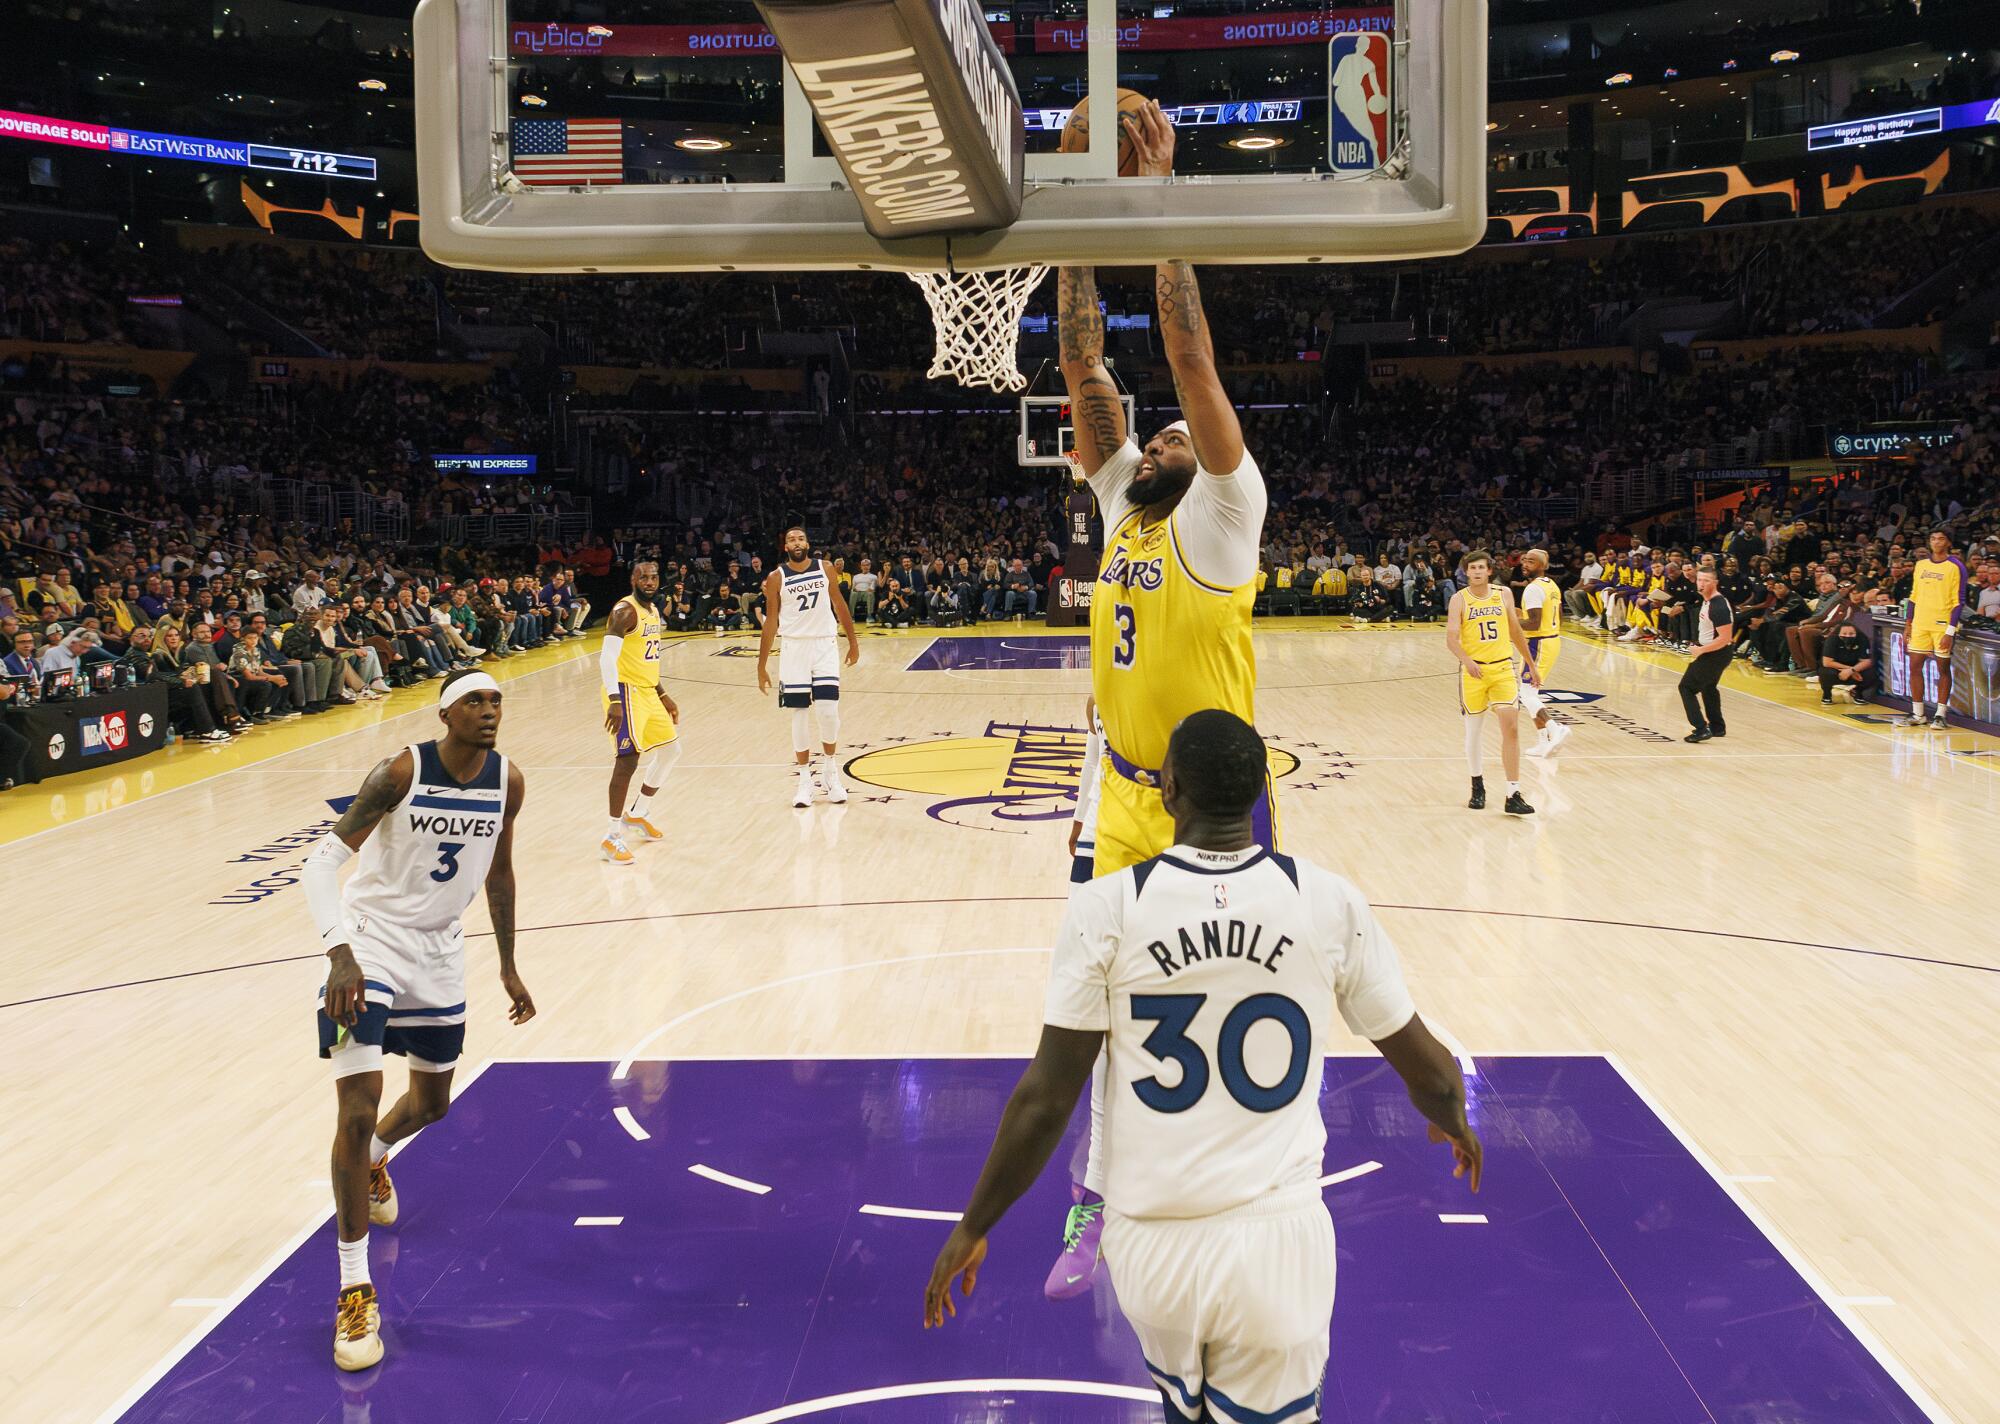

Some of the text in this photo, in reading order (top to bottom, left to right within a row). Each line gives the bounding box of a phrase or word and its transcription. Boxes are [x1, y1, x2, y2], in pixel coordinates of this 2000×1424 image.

[1194, 108, 1205, 123] 7
[1267, 109, 1275, 120] 0
[1285, 109, 1293, 120] 7
[1877, 119, 1914, 132] Birthday
[795, 46, 975, 225] LAKERS.COM
[1338, 141, 1367, 164] NBA
[289, 151, 338, 173] 7:12
[482, 459, 528, 469] EXPRESS
[1074, 512, 1086, 523] GET
[1074, 522, 1087, 533] THE
[1077, 532, 1089, 545] App
[787, 580, 825, 595] WOLVES
[1074, 579, 1097, 596] Leag
[796, 591, 820, 612] 27
[1468, 605, 1503, 620] LAKERS
[1113, 602, 1137, 671] 3
[1478, 620, 1498, 641] 15
[409, 813, 497, 838] WOLVES
[430, 841, 466, 883] 3
[1196, 852, 1239, 863] NIKE PRO
[1147, 919, 1294, 977] RANDLE
[1129, 992, 1312, 1114] 30
